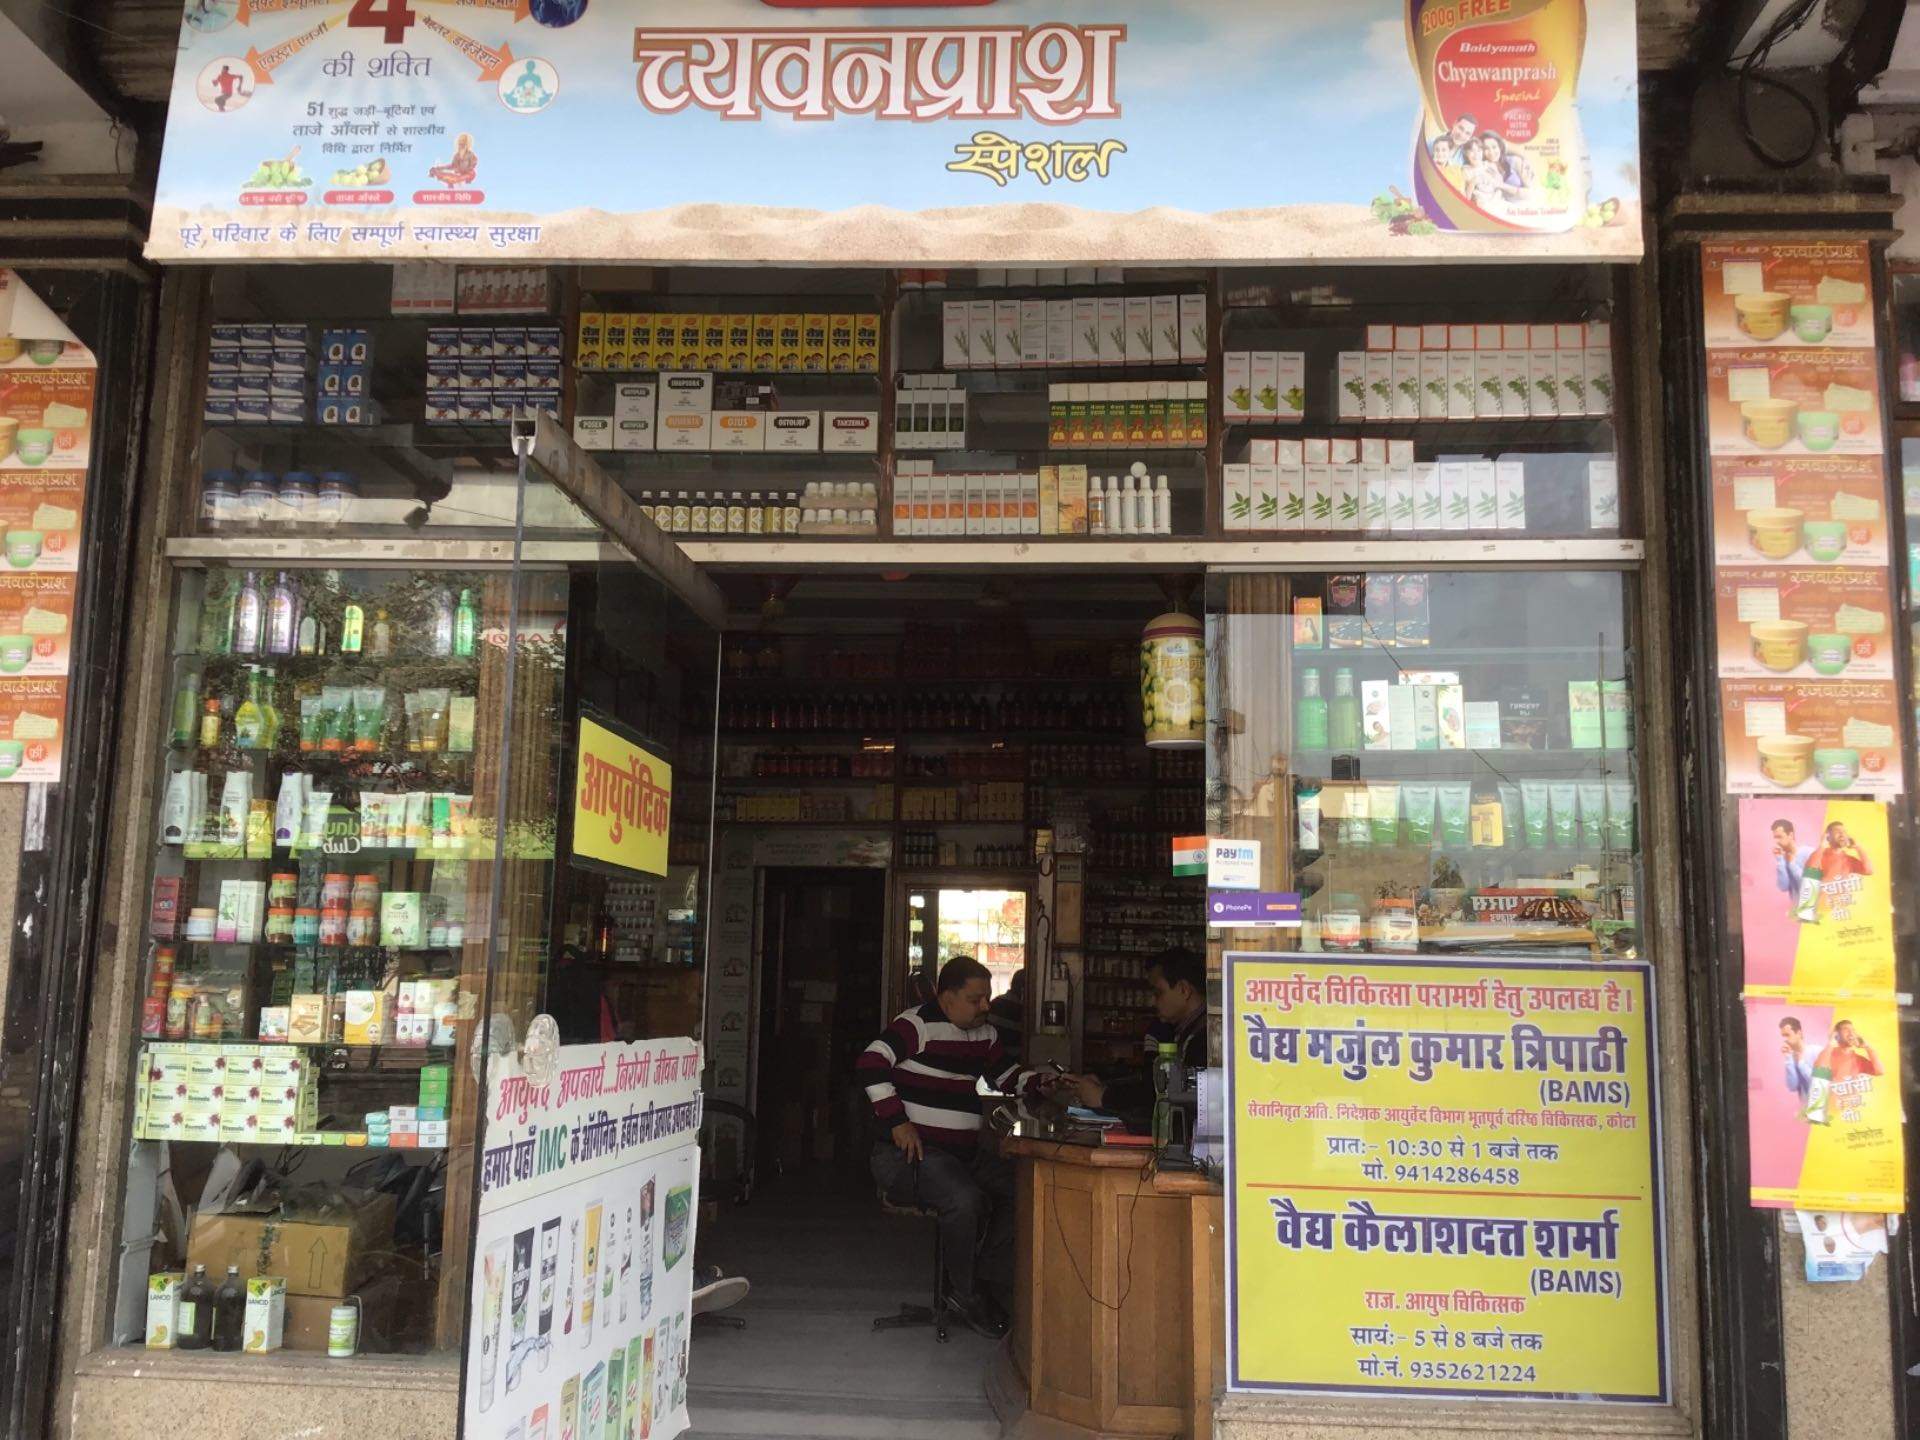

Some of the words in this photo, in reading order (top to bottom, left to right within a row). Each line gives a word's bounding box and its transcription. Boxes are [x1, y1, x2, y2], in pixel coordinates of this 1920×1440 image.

[346, 0, 415, 44] 4
[1421, 9, 1456, 36] 200g
[1457, 0, 1513, 20] FREE
[321, 51, 353, 77] की
[367, 50, 431, 78] शक्ति
[634, 22, 1127, 126] च्यवनप्राश
[1438, 61, 1557, 86] Chyawanprash
[306, 102, 324, 117] 51
[386, 124, 398, 136] से
[946, 130, 1127, 186] स्पेशल
[212, 223, 271, 242] परिवार
[280, 223, 298, 242] के
[307, 222, 342, 243] लिए
[351, 221, 405, 247] सम्पूर्ण
[413, 226, 480, 242] स्वास्थ्य
[488, 226, 542, 247] सुरक्षा
[580, 752, 672, 844] आयुर्वेदिक
[1247, 974, 1321, 1011] आयुर्वेद
[1326, 975, 1412, 1006] चिकित्सा
[1416, 979, 1488, 1008] परामर्श
[1492, 979, 1525, 1017] हेतु
[1527, 987, 1602, 1011] उपलब्ध
[1243, 1014, 1301, 1063] वैद्य
[1408, 1031, 1506, 1081] कुमार
[1511, 1024, 1628, 1074] त्रिपाठी
[654, 1048, 680, 1086] जीवन
[1540, 1079, 1630, 1108] (BAMS)
[1304, 1102, 1333, 1120] अति.
[1336, 1103, 1381, 1120] निदेशक
[1385, 1105, 1428, 1126] आयुर्वेद
[1430, 1106, 1464, 1124] विभाग
[1468, 1108, 1504, 1128] भूतपूर्व
[1606, 1112, 1637, 1129] कोटा
[483, 1131, 514, 1191] हमारे
[514, 1125, 537, 1181] यहाँ
[537, 1124, 568, 1176] IMC
[570, 1115, 581, 1165] के
[1387, 1139, 1442, 1158] 10:30
[1447, 1135, 1465, 1158] से
[1472, 1141, 1480, 1158] 1
[1487, 1137, 1521, 1159] बजे
[1524, 1144, 1559, 1161] तक
[1361, 1157, 1388, 1180] मो.
[1394, 1163, 1520, 1186] 9414286458
[1270, 1198, 1336, 1250] वैद्य
[1342, 1200, 1528, 1257] कैलाशदत्त
[1532, 1209, 1620, 1260] शर्मा
[1529, 1269, 1622, 1298] (BAMS)
[1365, 1291, 1401, 1311] राज.
[1405, 1291, 1450, 1317] आयुष
[1453, 1290, 1527, 1314] चिकित्सक
[1414, 1330, 1426, 1348] 5
[1431, 1325, 1448, 1348] से
[1454, 1331, 1466, 1348] 8
[1471, 1326, 1504, 1350] बजे
[1511, 1333, 1543, 1350] तक
[1410, 1361, 1537, 1382] 9352621224
